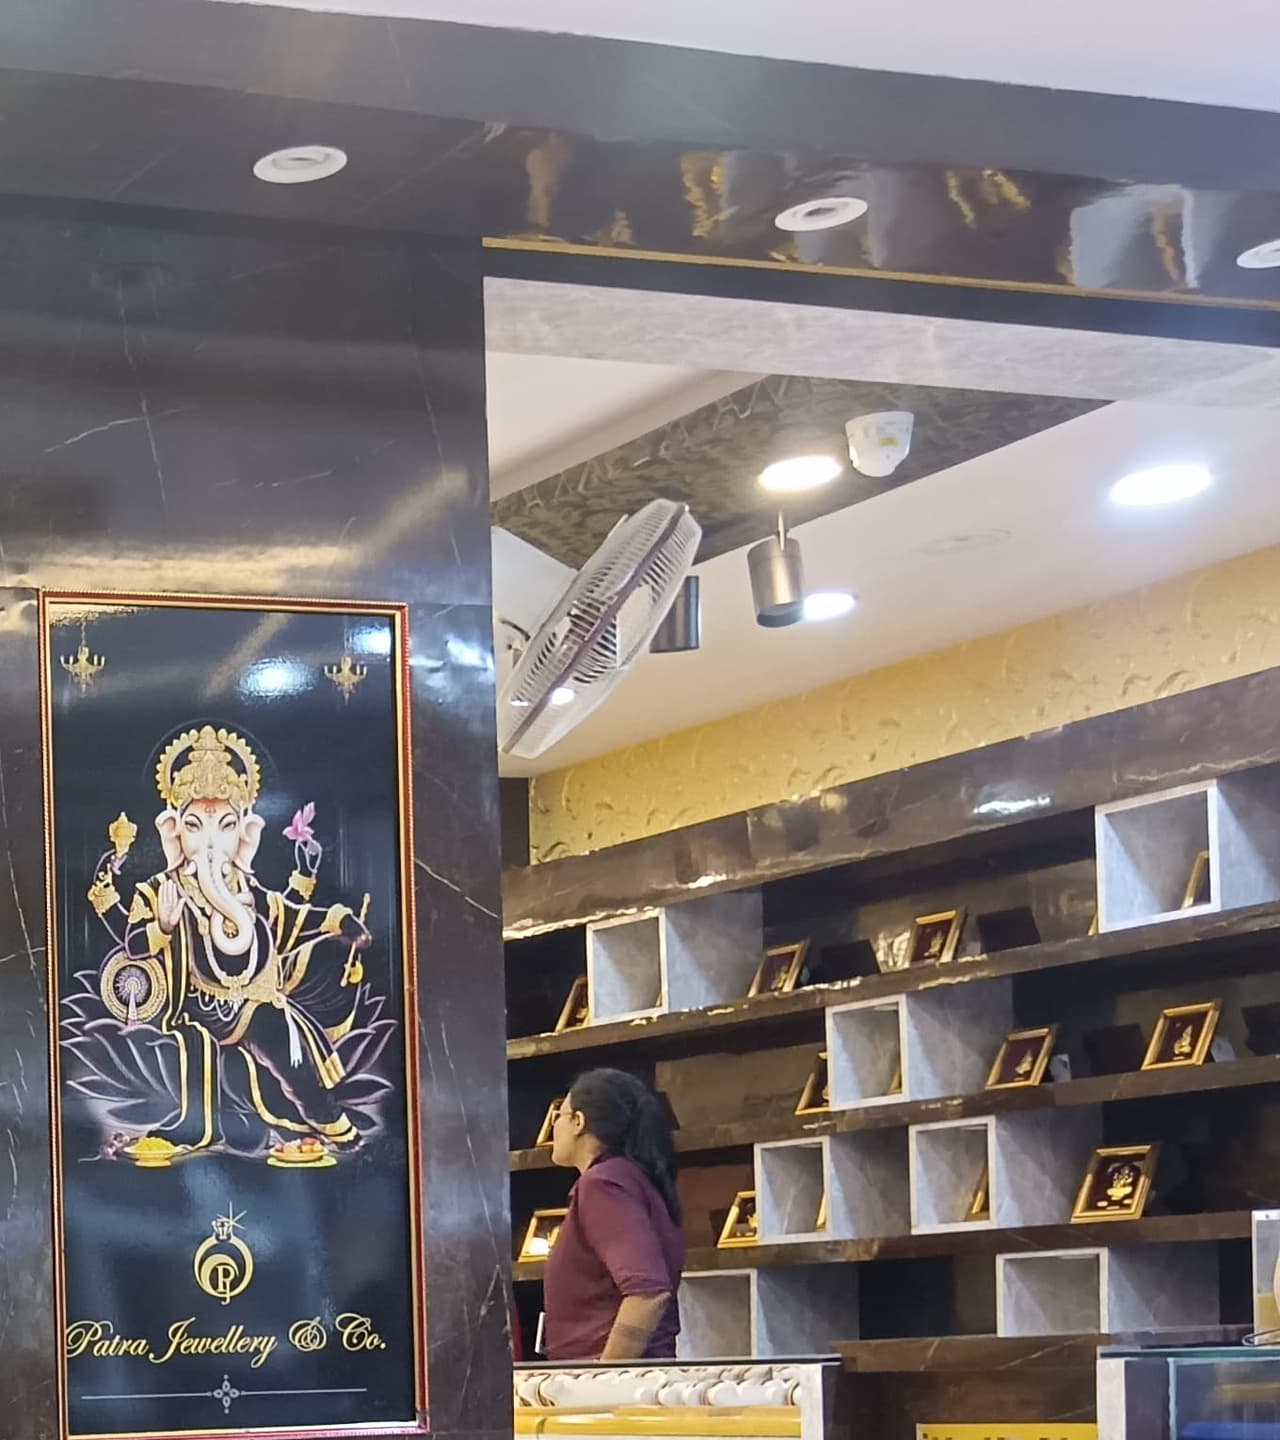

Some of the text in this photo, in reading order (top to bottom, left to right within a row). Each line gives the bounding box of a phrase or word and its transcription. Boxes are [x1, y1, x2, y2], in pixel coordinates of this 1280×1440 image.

[66, 1312, 387, 1368] Patra Jewellery & Co.
